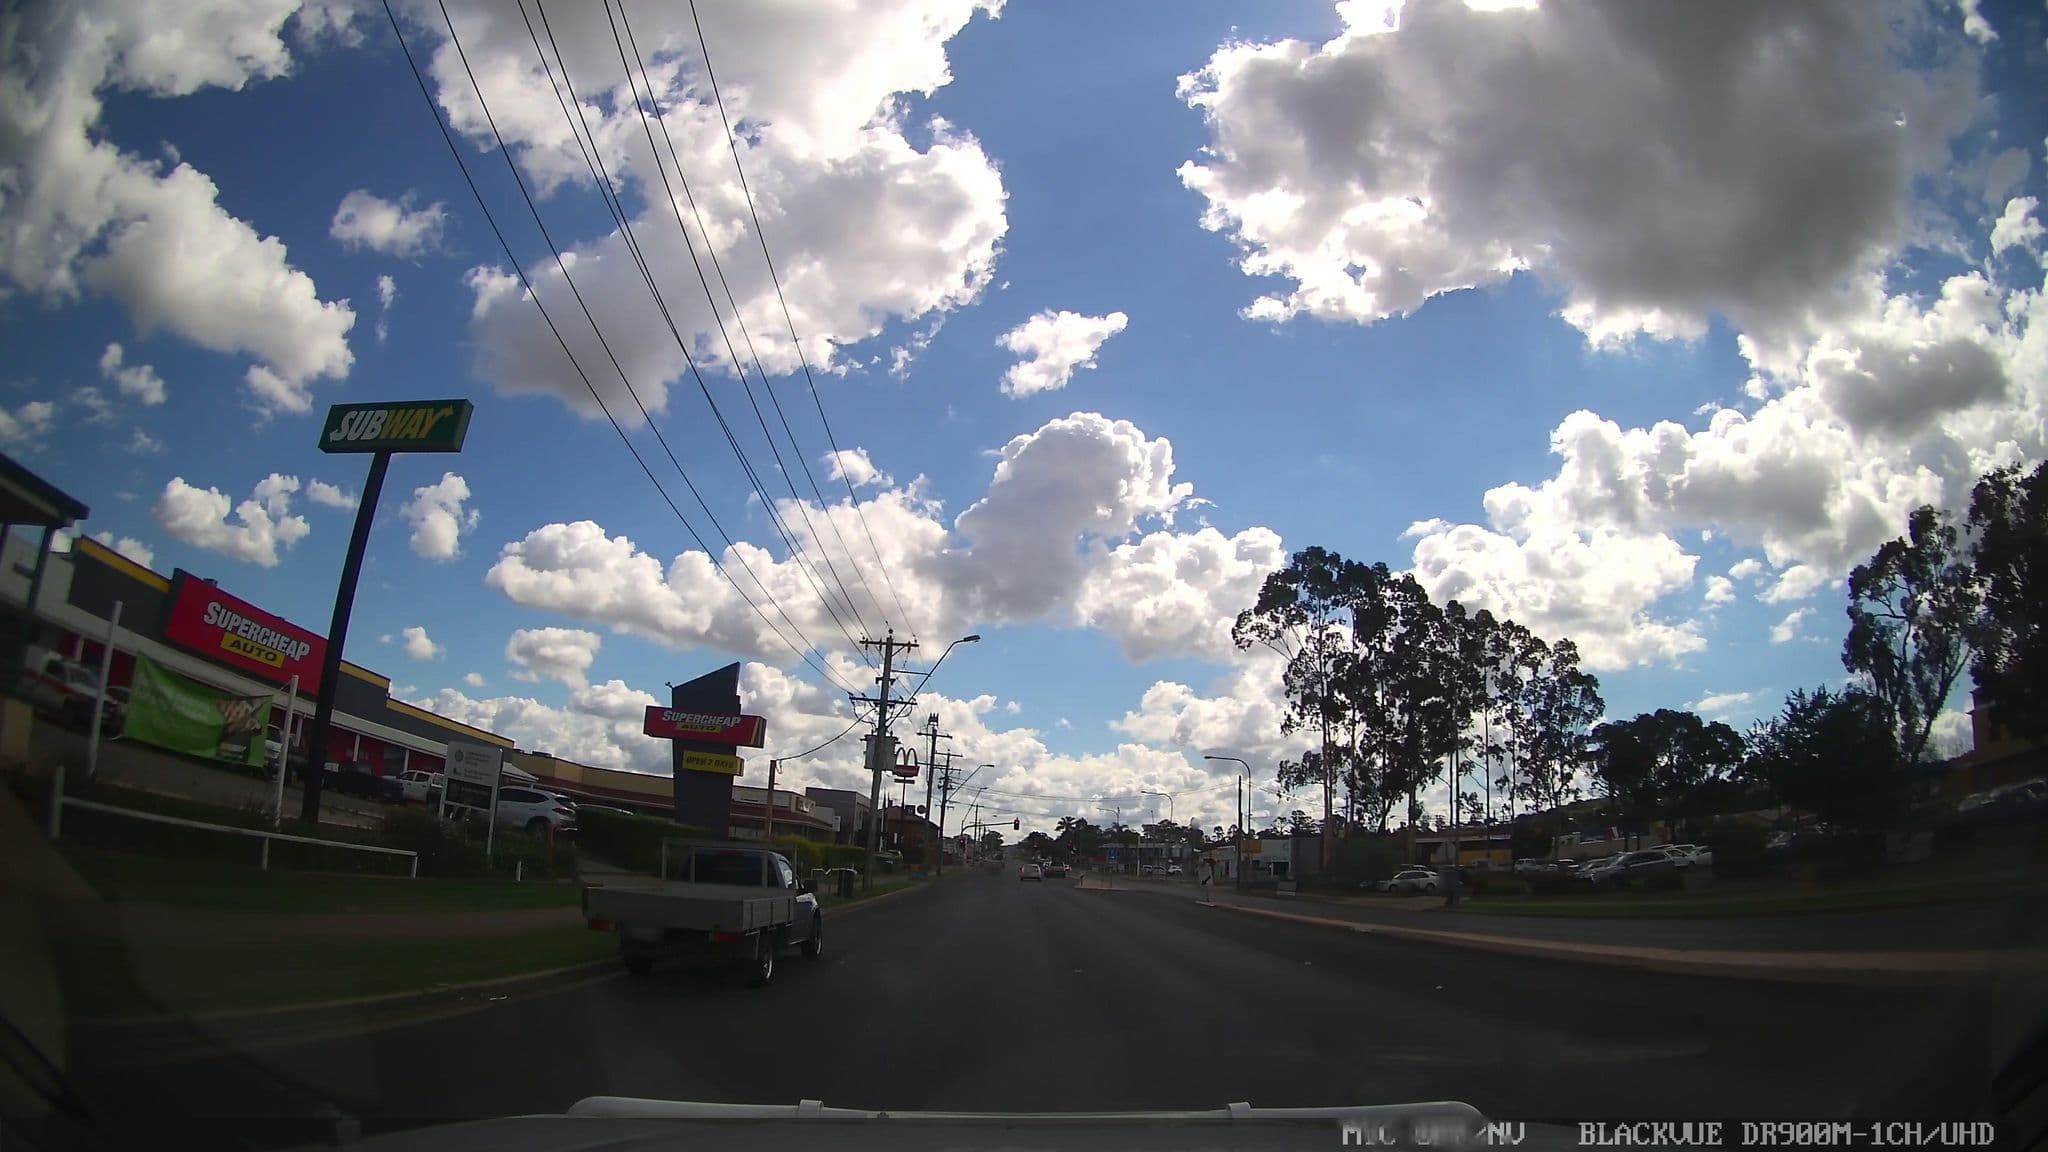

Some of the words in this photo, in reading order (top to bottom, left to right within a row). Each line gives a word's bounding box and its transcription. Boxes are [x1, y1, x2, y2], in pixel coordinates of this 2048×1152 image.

[329, 405, 454, 442] SUBWAY
[203, 601, 310, 661] SUPERCHEAP
[229, 640, 278, 662] AUTO
[662, 710, 741, 727] SUPERCHEAP
[680, 724, 717, 732] AUTO
